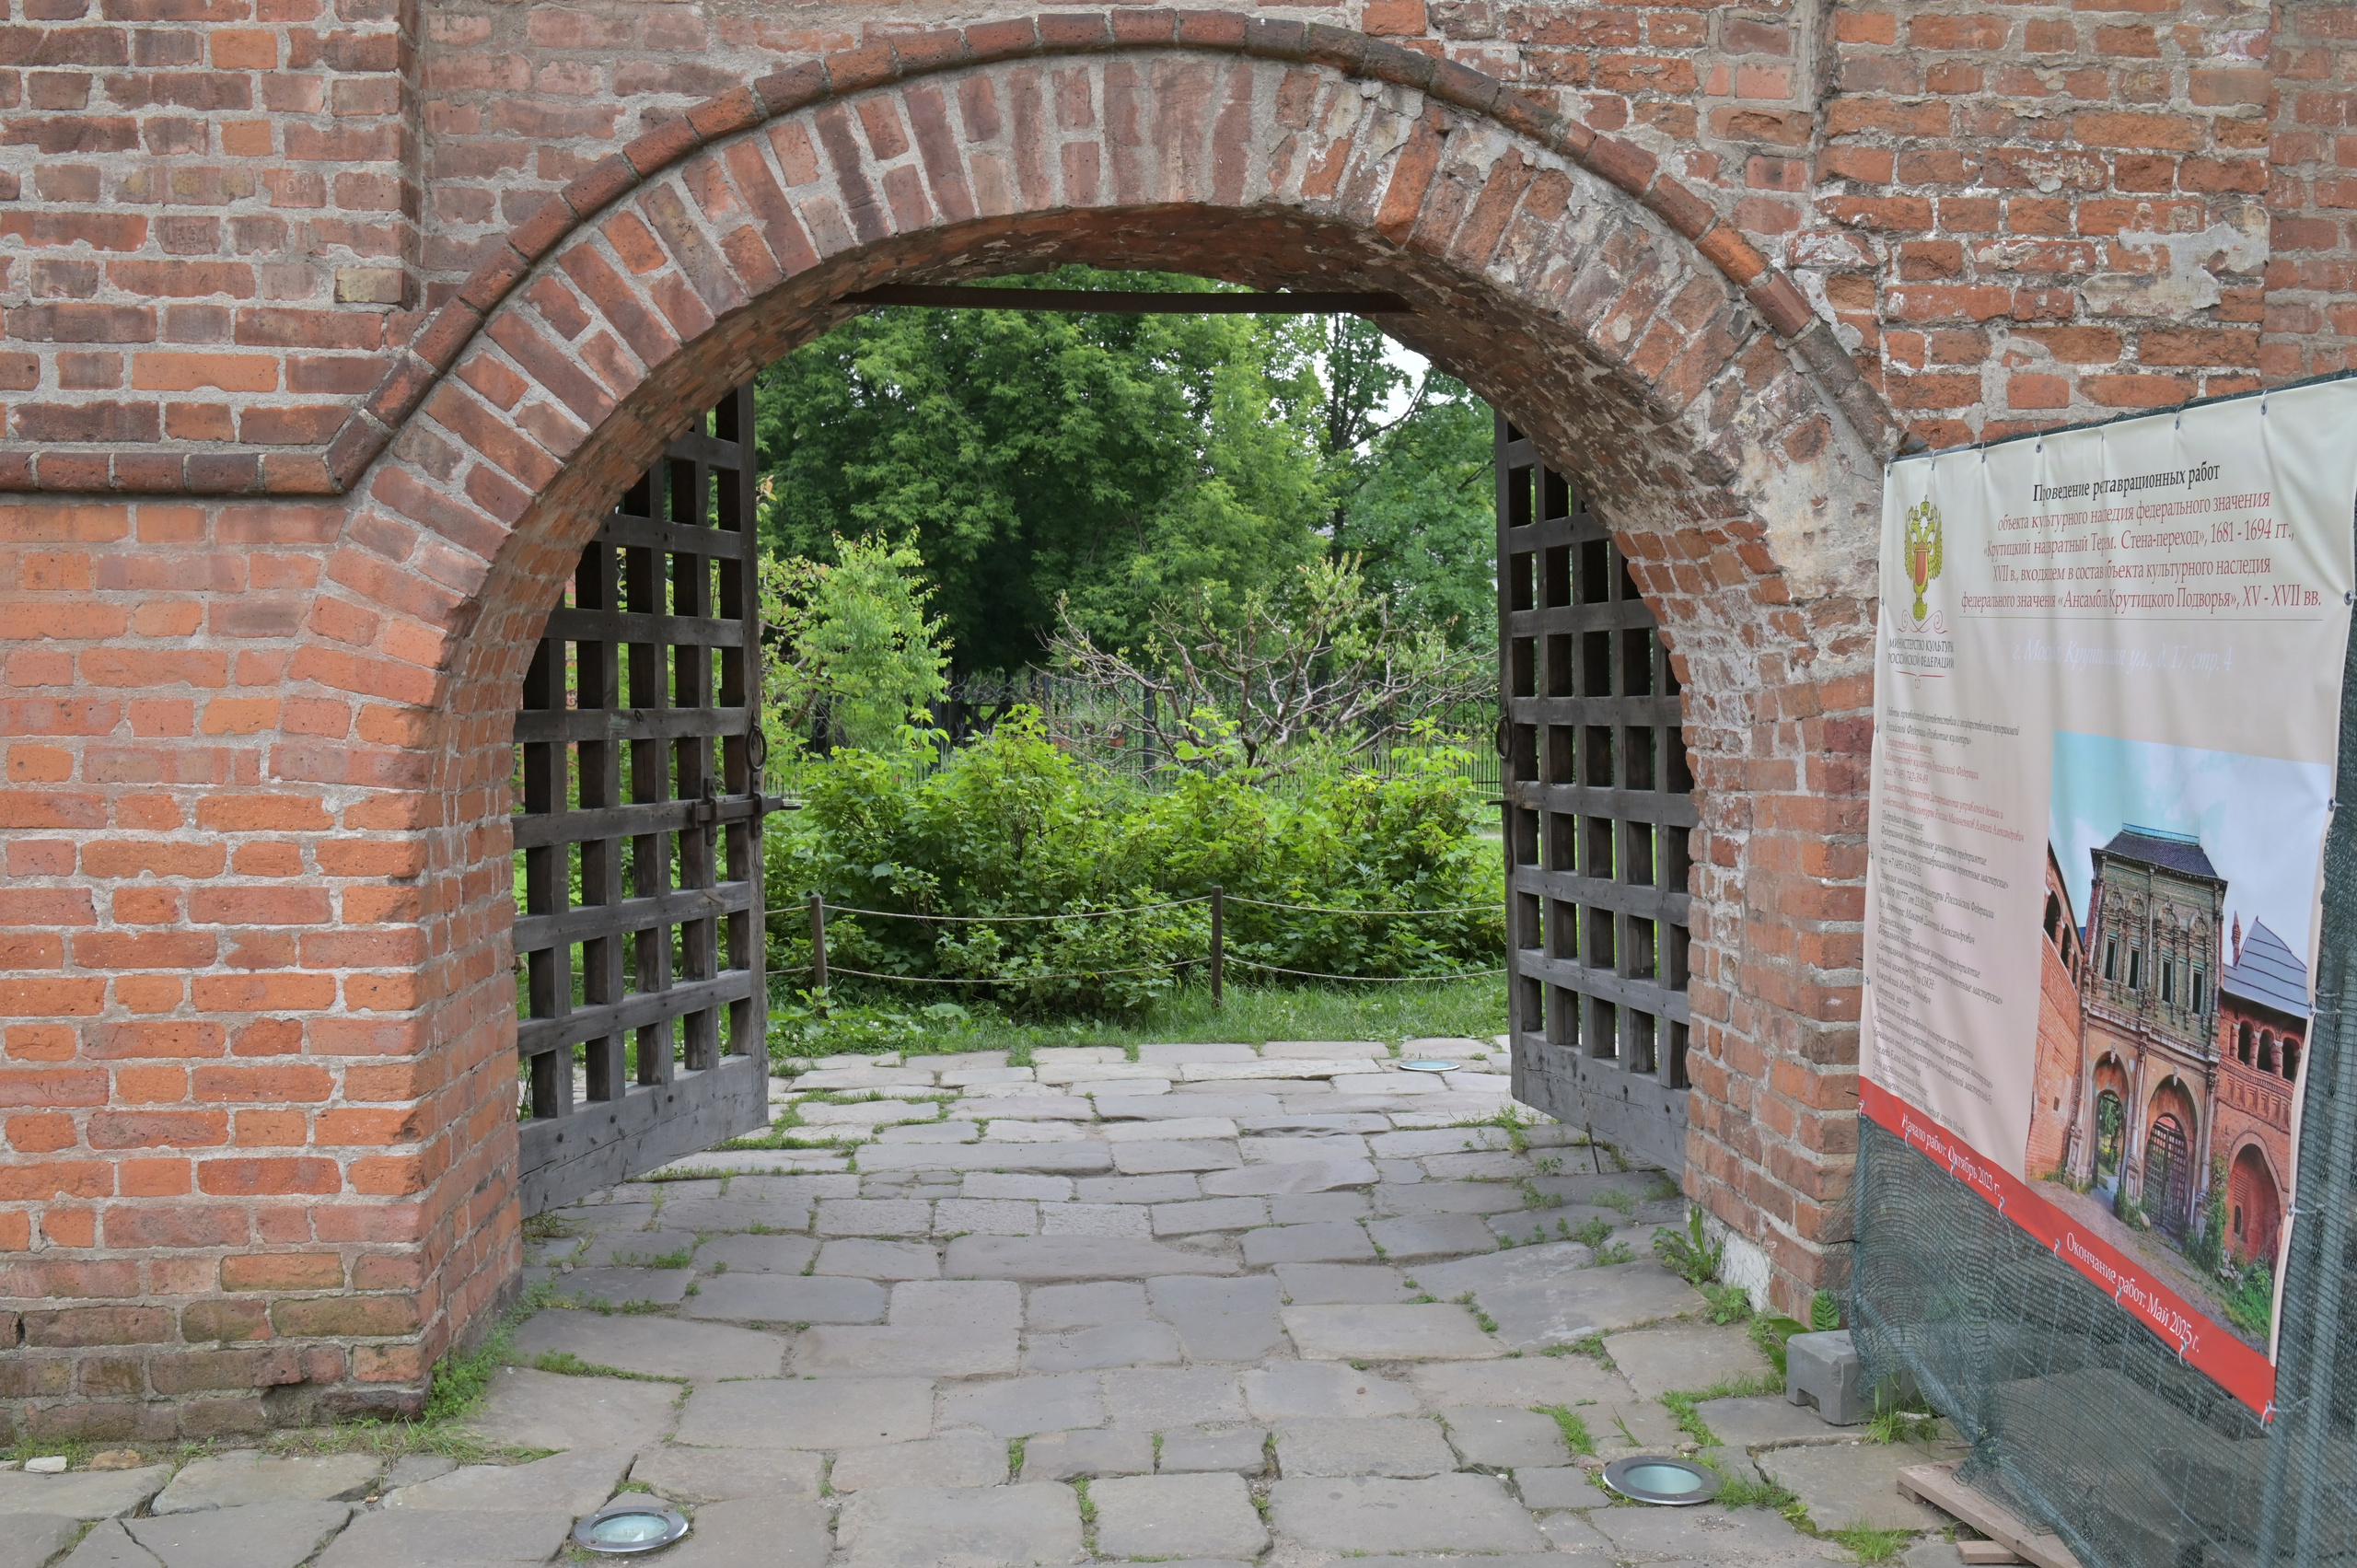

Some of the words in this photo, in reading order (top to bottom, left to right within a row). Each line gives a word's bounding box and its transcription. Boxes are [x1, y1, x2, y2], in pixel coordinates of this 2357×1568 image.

[2033, 482, 2089, 506] Проведение
[2188, 461, 2220, 490] работ
[1998, 514, 2028, 531] объекта
[2137, 497, 2210, 526] федерального
[2212, 492, 2270, 512] значения
[2120, 528, 2208, 554] Стена-переход»,
[2211, 520, 2234, 543] 1681
[2244, 517, 2272, 540] 1694
[1992, 564, 2008, 582] XVII
[2068, 568, 2073, 580] в
[2075, 566, 2104, 580] состав
[2146, 559, 2213, 584] культурного
[2215, 557, 2270, 577] наследия
[1961, 591, 2014, 613] федерального
[2109, 588, 2174, 614] Крутицкого
[2177, 587, 2240, 614] Подворья»,
[2243, 585, 2262, 607] XV
[2271, 584, 2300, 607] XVII
[2304, 590, 2321, 606] вв.
[1921, 656, 1954, 668] ФЕДЕРАЦИИ
[1926, 640, 1954, 653] КУЛЬТУРЫ
[2170, 645, 2189, 672] 17,
[2223, 645, 2233, 671] 4
[1901, 1113, 1926, 1142] Начало
[1948, 1145, 1978, 1180] Октябрь
[1978, 1167, 1993, 1191] 2023
[1994, 1182, 2000, 1197] г.
[2066, 1233, 2116, 1284] Окончание
[2147, 1292, 2169, 1328] Май
[2169, 1311, 2192, 1344] 2025
[2191, 1334, 2200, 1353] г.
